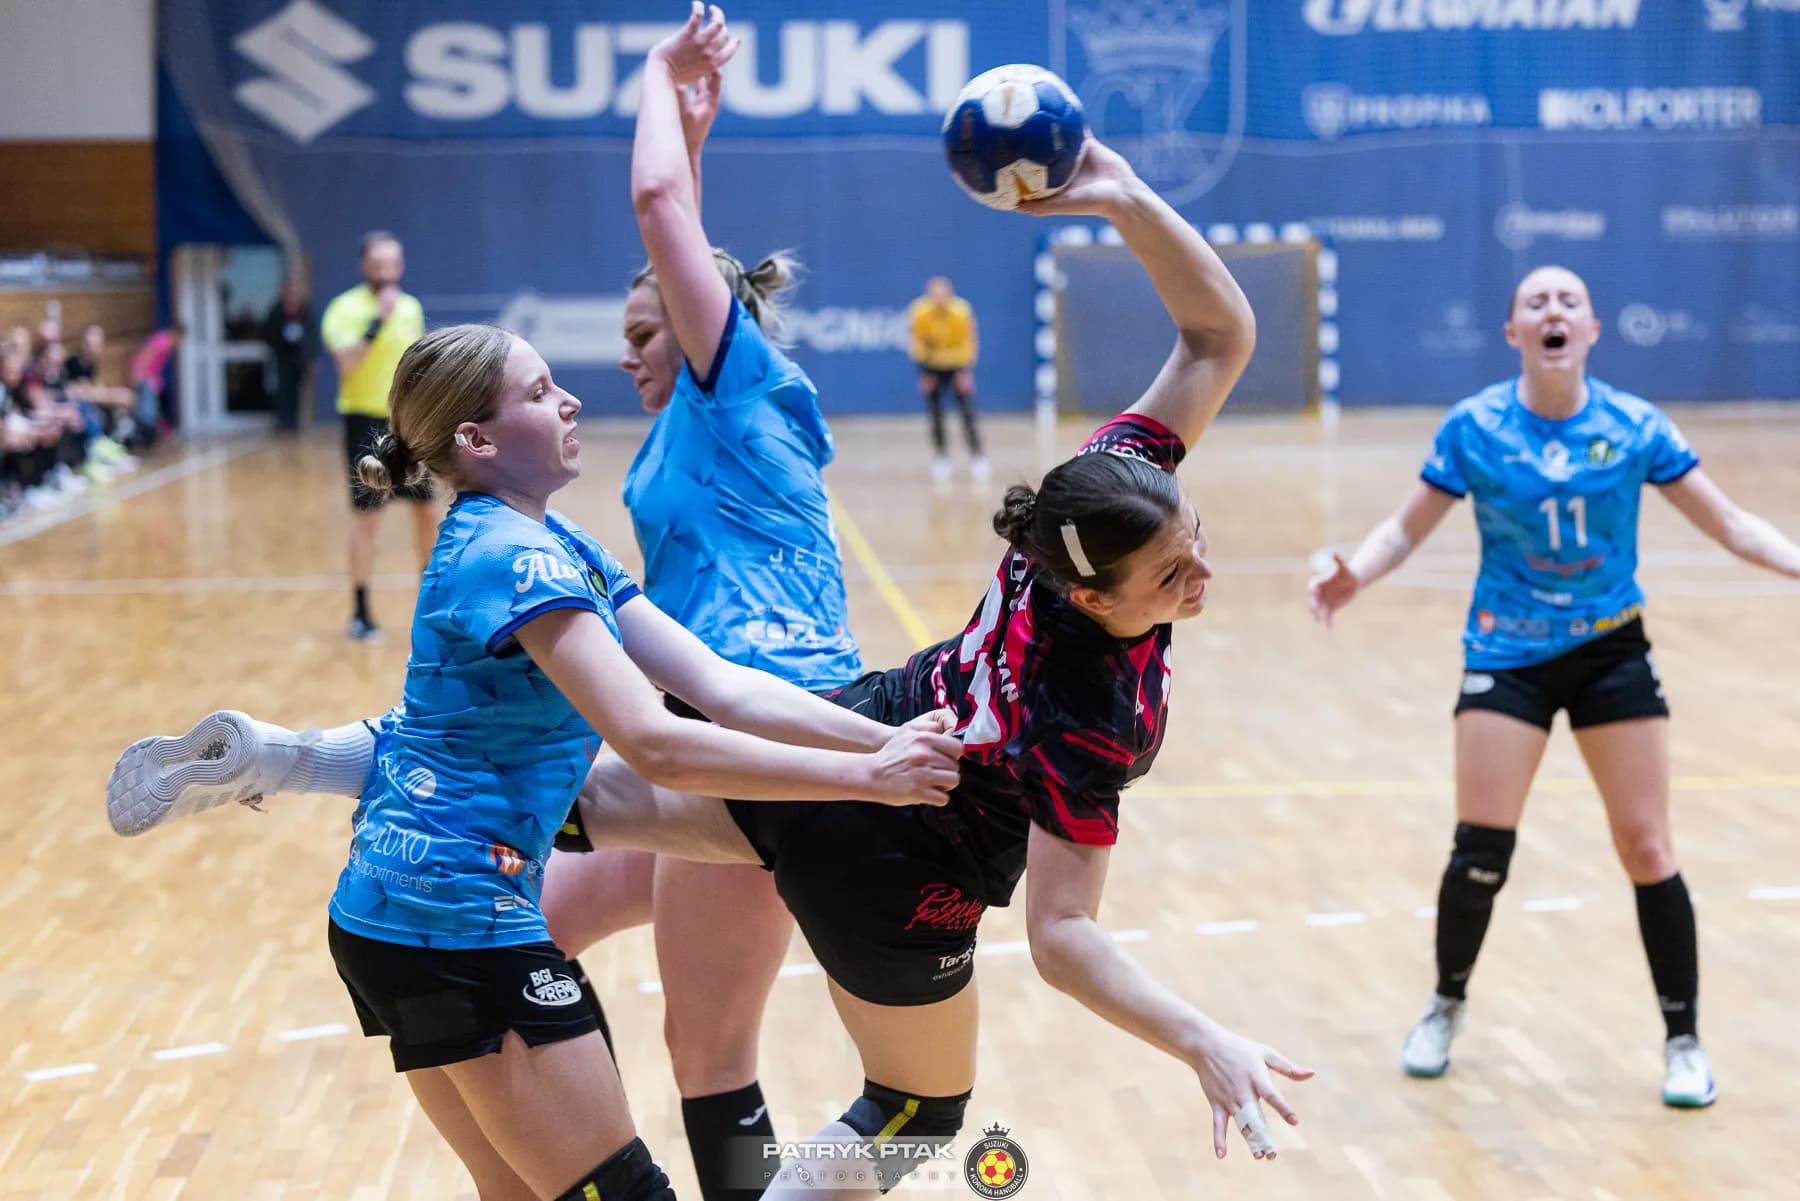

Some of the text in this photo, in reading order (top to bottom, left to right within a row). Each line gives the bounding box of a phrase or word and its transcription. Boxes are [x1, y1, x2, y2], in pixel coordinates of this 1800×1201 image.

[1539, 495, 1588, 551] 11
[373, 821, 430, 864] LUXO
[529, 968, 554, 987] BGI
